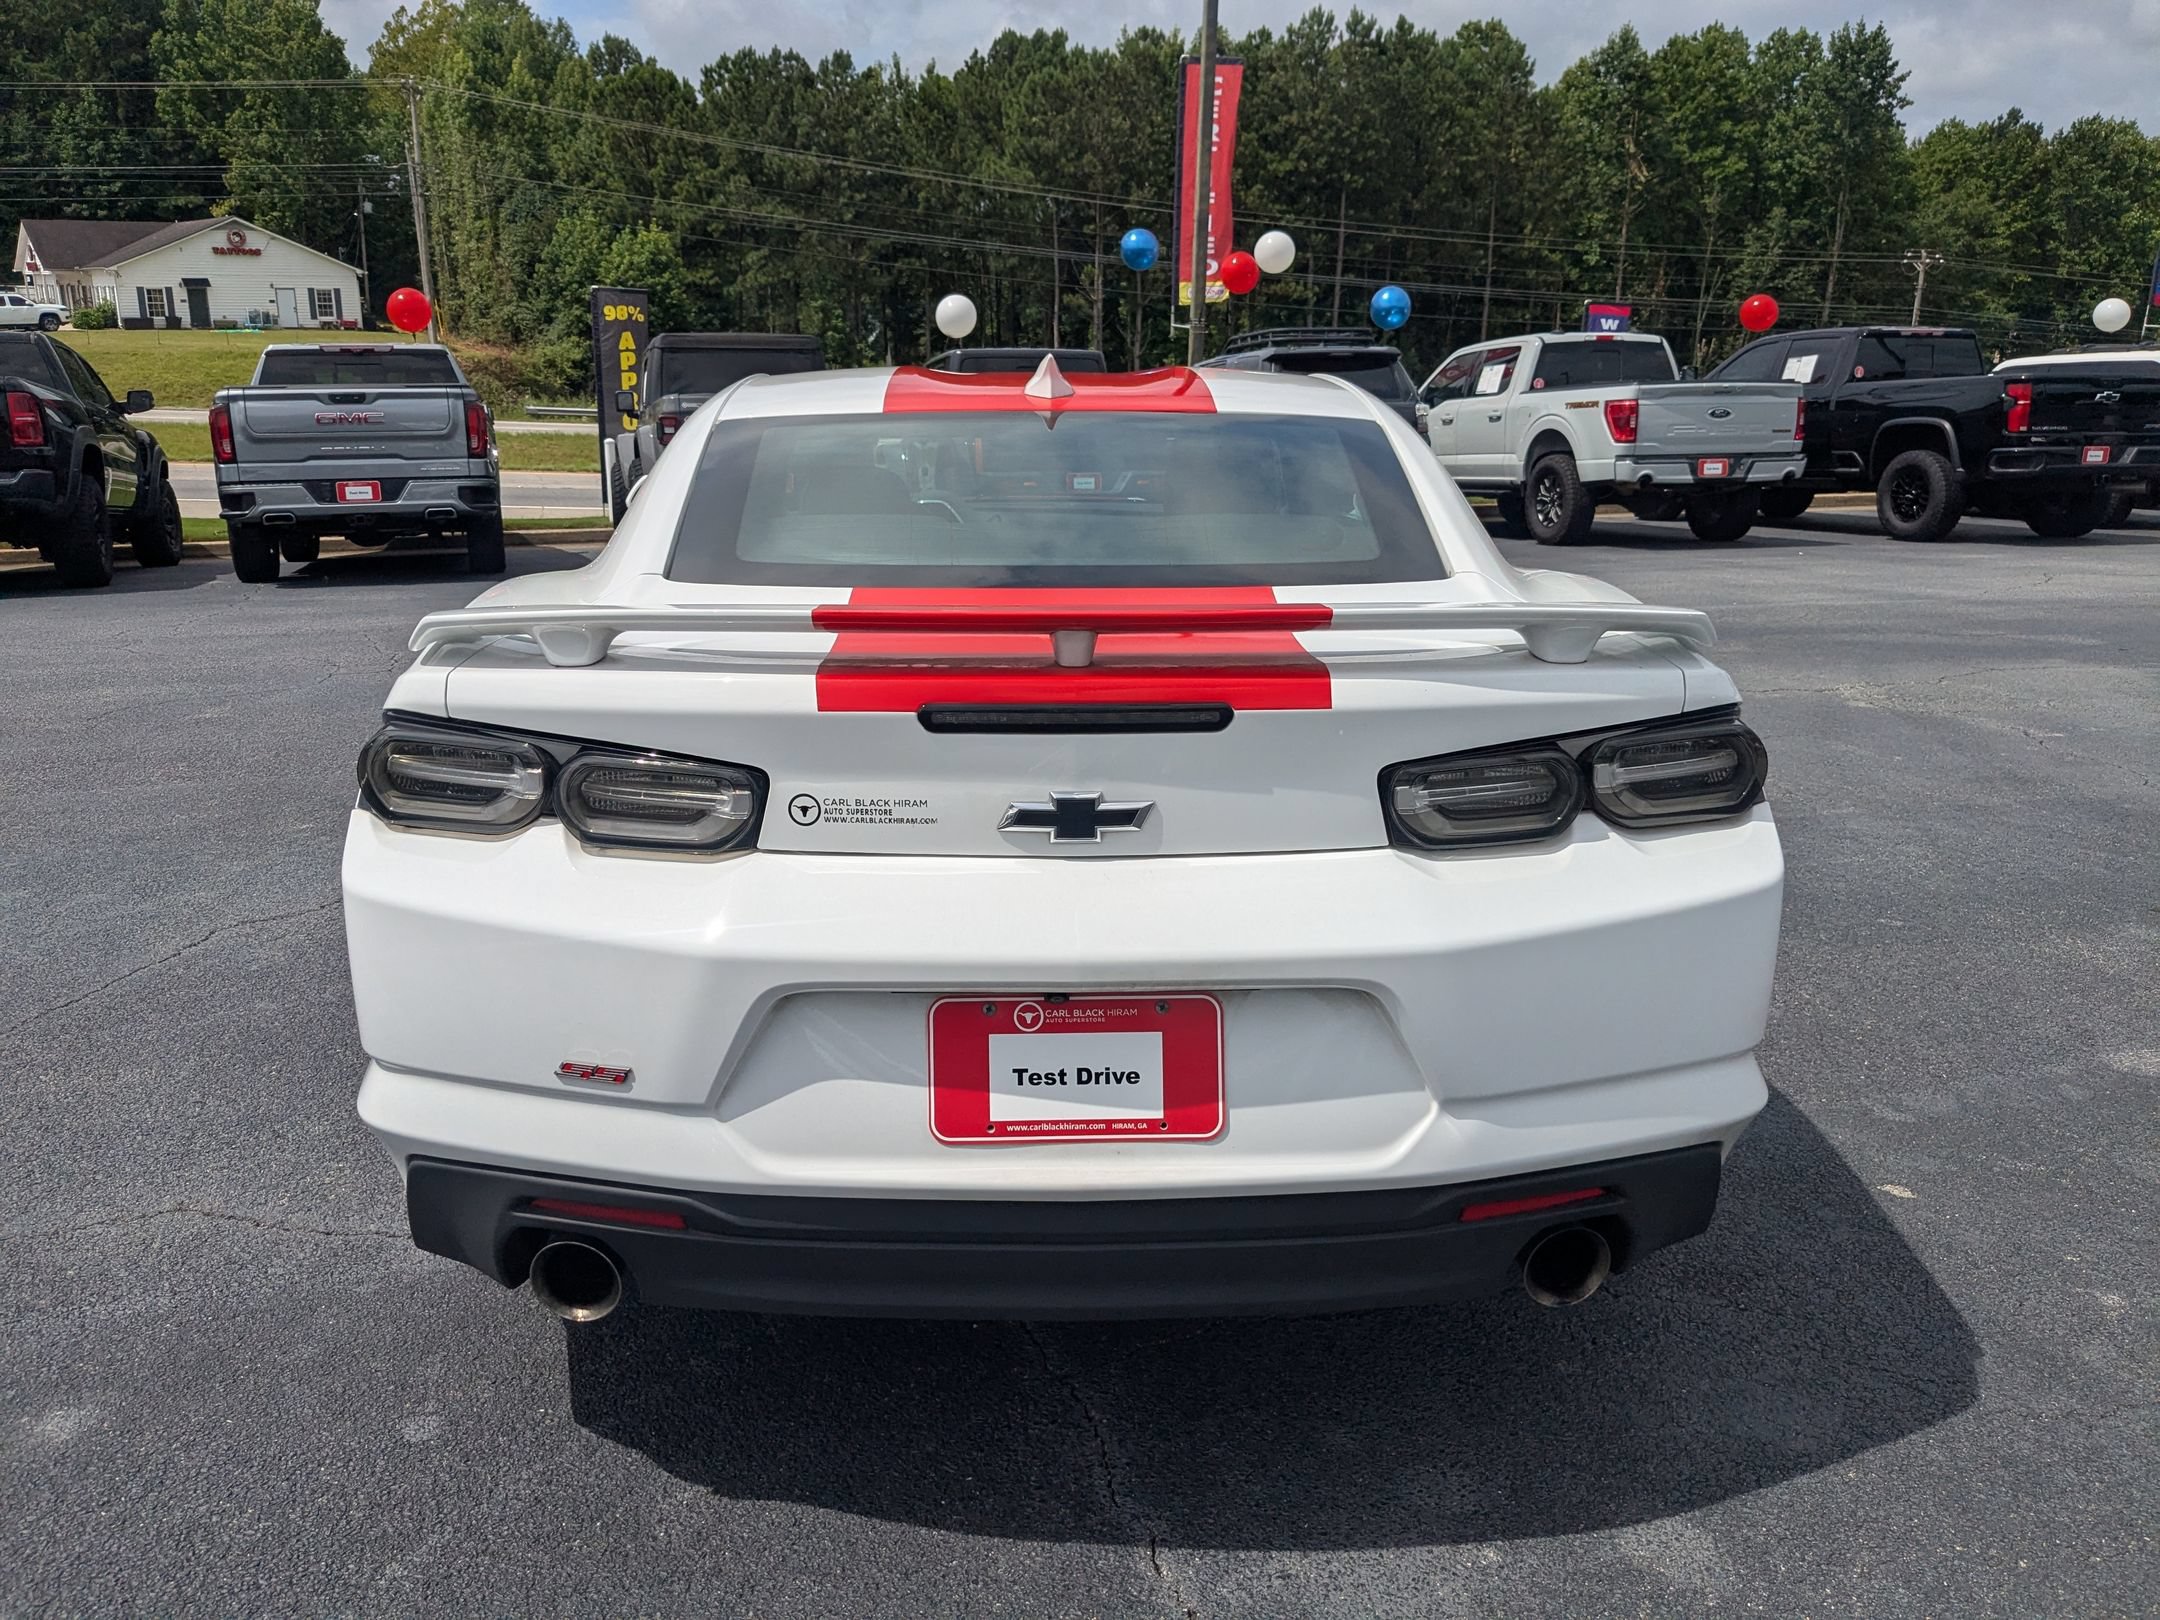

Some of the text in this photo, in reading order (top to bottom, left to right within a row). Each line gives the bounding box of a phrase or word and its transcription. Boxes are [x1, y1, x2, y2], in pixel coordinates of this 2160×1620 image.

[603, 305, 645, 322] 98%
[314, 412, 385, 425] GMC
[823, 798, 928, 808] CARL BLACK HIRAM
[846, 808, 893, 816] SUPERSTORE
[823, 816, 938, 825] WWW.CARLBLACKHIRAM.COM
[1045, 1008, 1138, 1017] CARL BLACK HIRAM
[1012, 1067, 1141, 1086] Test Drive
[1006, 1122, 1106, 1132] www.carlblackhiram.com
